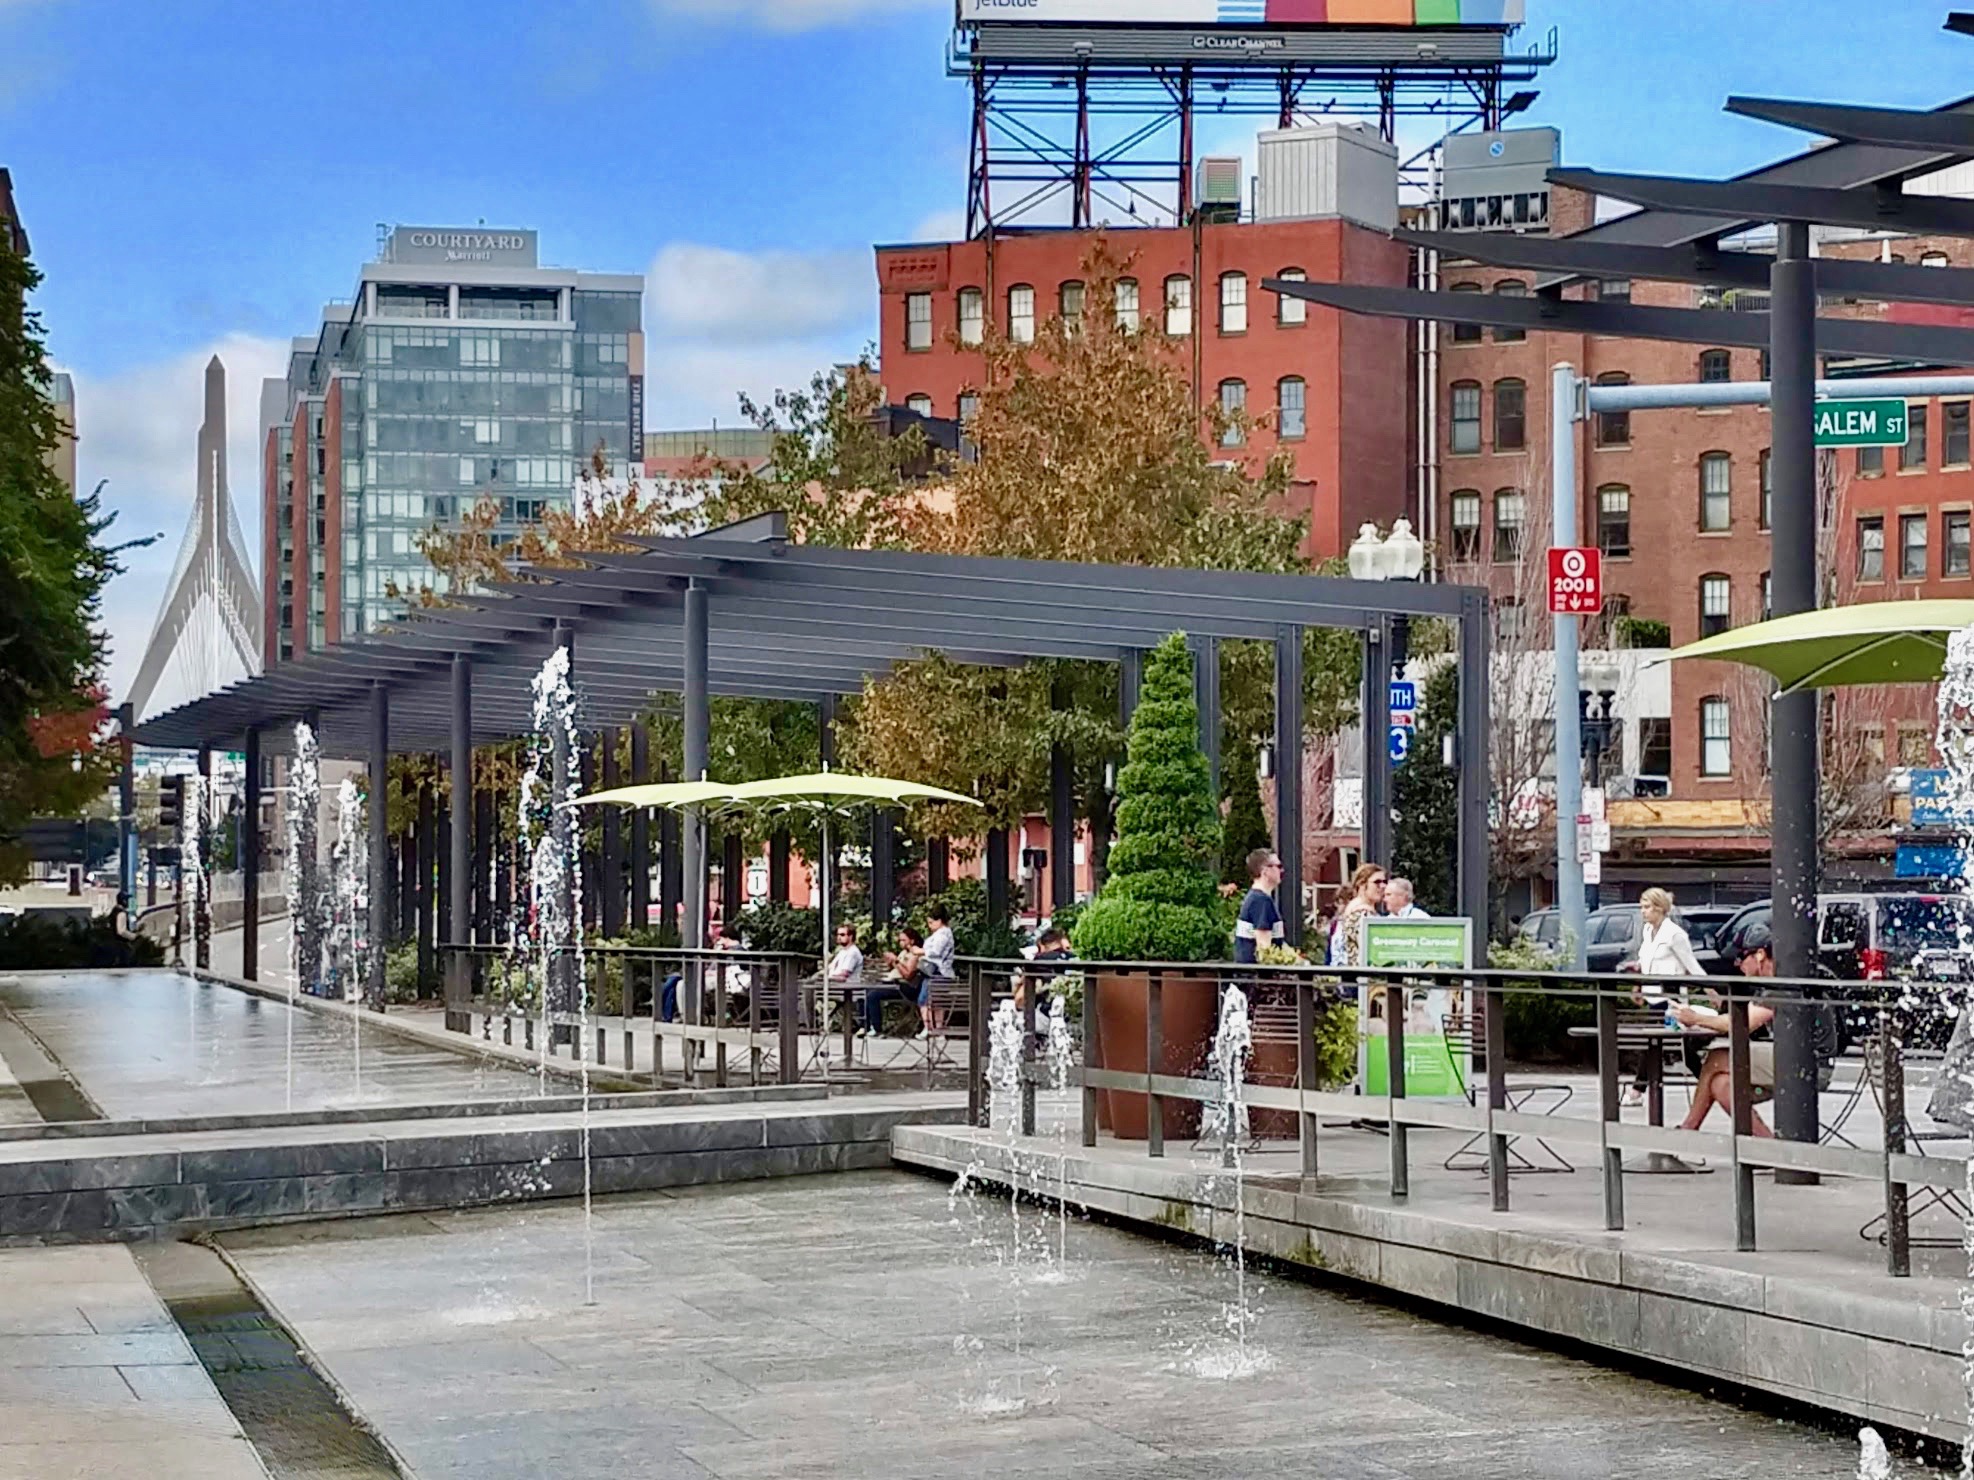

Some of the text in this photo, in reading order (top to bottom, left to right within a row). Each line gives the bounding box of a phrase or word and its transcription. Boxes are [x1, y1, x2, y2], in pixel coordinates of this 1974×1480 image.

[411, 232, 524, 250] COURTYARD
[445, 250, 491, 262] Marriott
[1886, 417, 1903, 434] ST
